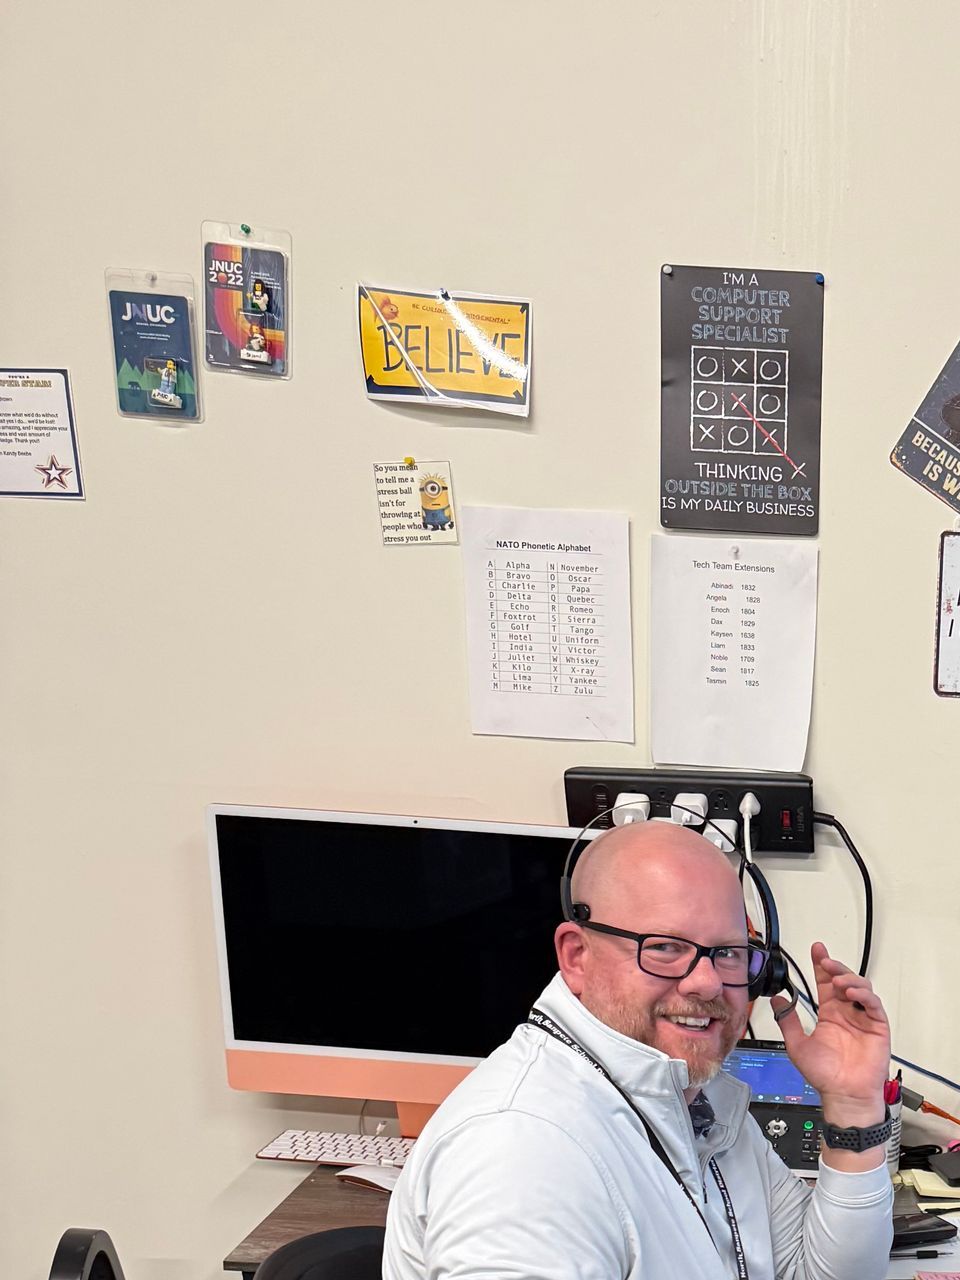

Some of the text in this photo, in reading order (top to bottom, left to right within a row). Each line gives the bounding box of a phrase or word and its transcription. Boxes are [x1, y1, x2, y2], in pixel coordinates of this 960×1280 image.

[208, 260, 243, 274] JNUC
[723, 272, 759, 286] I'M A
[690, 286, 791, 307] COMPUTER
[121, 302, 176, 324] JNUC
[698, 305, 783, 326] SUPPORT
[690, 323, 790, 344] SPECIALIST
[376, 322, 521, 379] BELIEVE
[385, 465, 398, 473] you
[694, 462, 783, 482] THINKING
[922, 460, 943, 482] IS
[400, 487, 412, 495] ball
[664, 478, 812, 501] OUTSIDE THE BOX
[395, 499, 406, 507] for
[662, 496, 815, 518] IS MY DAILY BUSINESS
[381, 511, 412, 519] throwing
[382, 522, 422, 532] people who
[384, 535, 404, 543] stress
[496, 541, 591, 552] NATO Phonetic Alphabet
[506, 561, 530, 570] Alpha
[561, 564, 599, 572] November
[693, 560, 775, 574] Tech Team Extensions
[506, 572, 531, 580] Bravo
[502, 581, 536, 590] Charlie
[571, 585, 590, 594] Papa
[507, 592, 532, 600] Delta
[567, 595, 595, 603] Quebec
[706, 594, 727, 602] Angela
[510, 603, 530, 611] Echo
[570, 606, 593, 614] Romeo
[503, 613, 536, 621] Foxtrot
[568, 615, 596, 624] Sierra
[511, 623, 529, 631] Golf
[570, 626, 594, 635] Tango
[948, 619, 954, 637] I
[509, 633, 532, 641] Hotel
[566, 636, 599, 644] Uniform
[711, 630, 733, 638] Kaysen
[510, 643, 533, 651] India
[508, 653, 535, 661] Juliet
[566, 656, 599, 666] Whiskey
[571, 667, 595, 676] X-ray
[711, 665, 727, 673] Sean
[569, 677, 598, 685] Yankee
